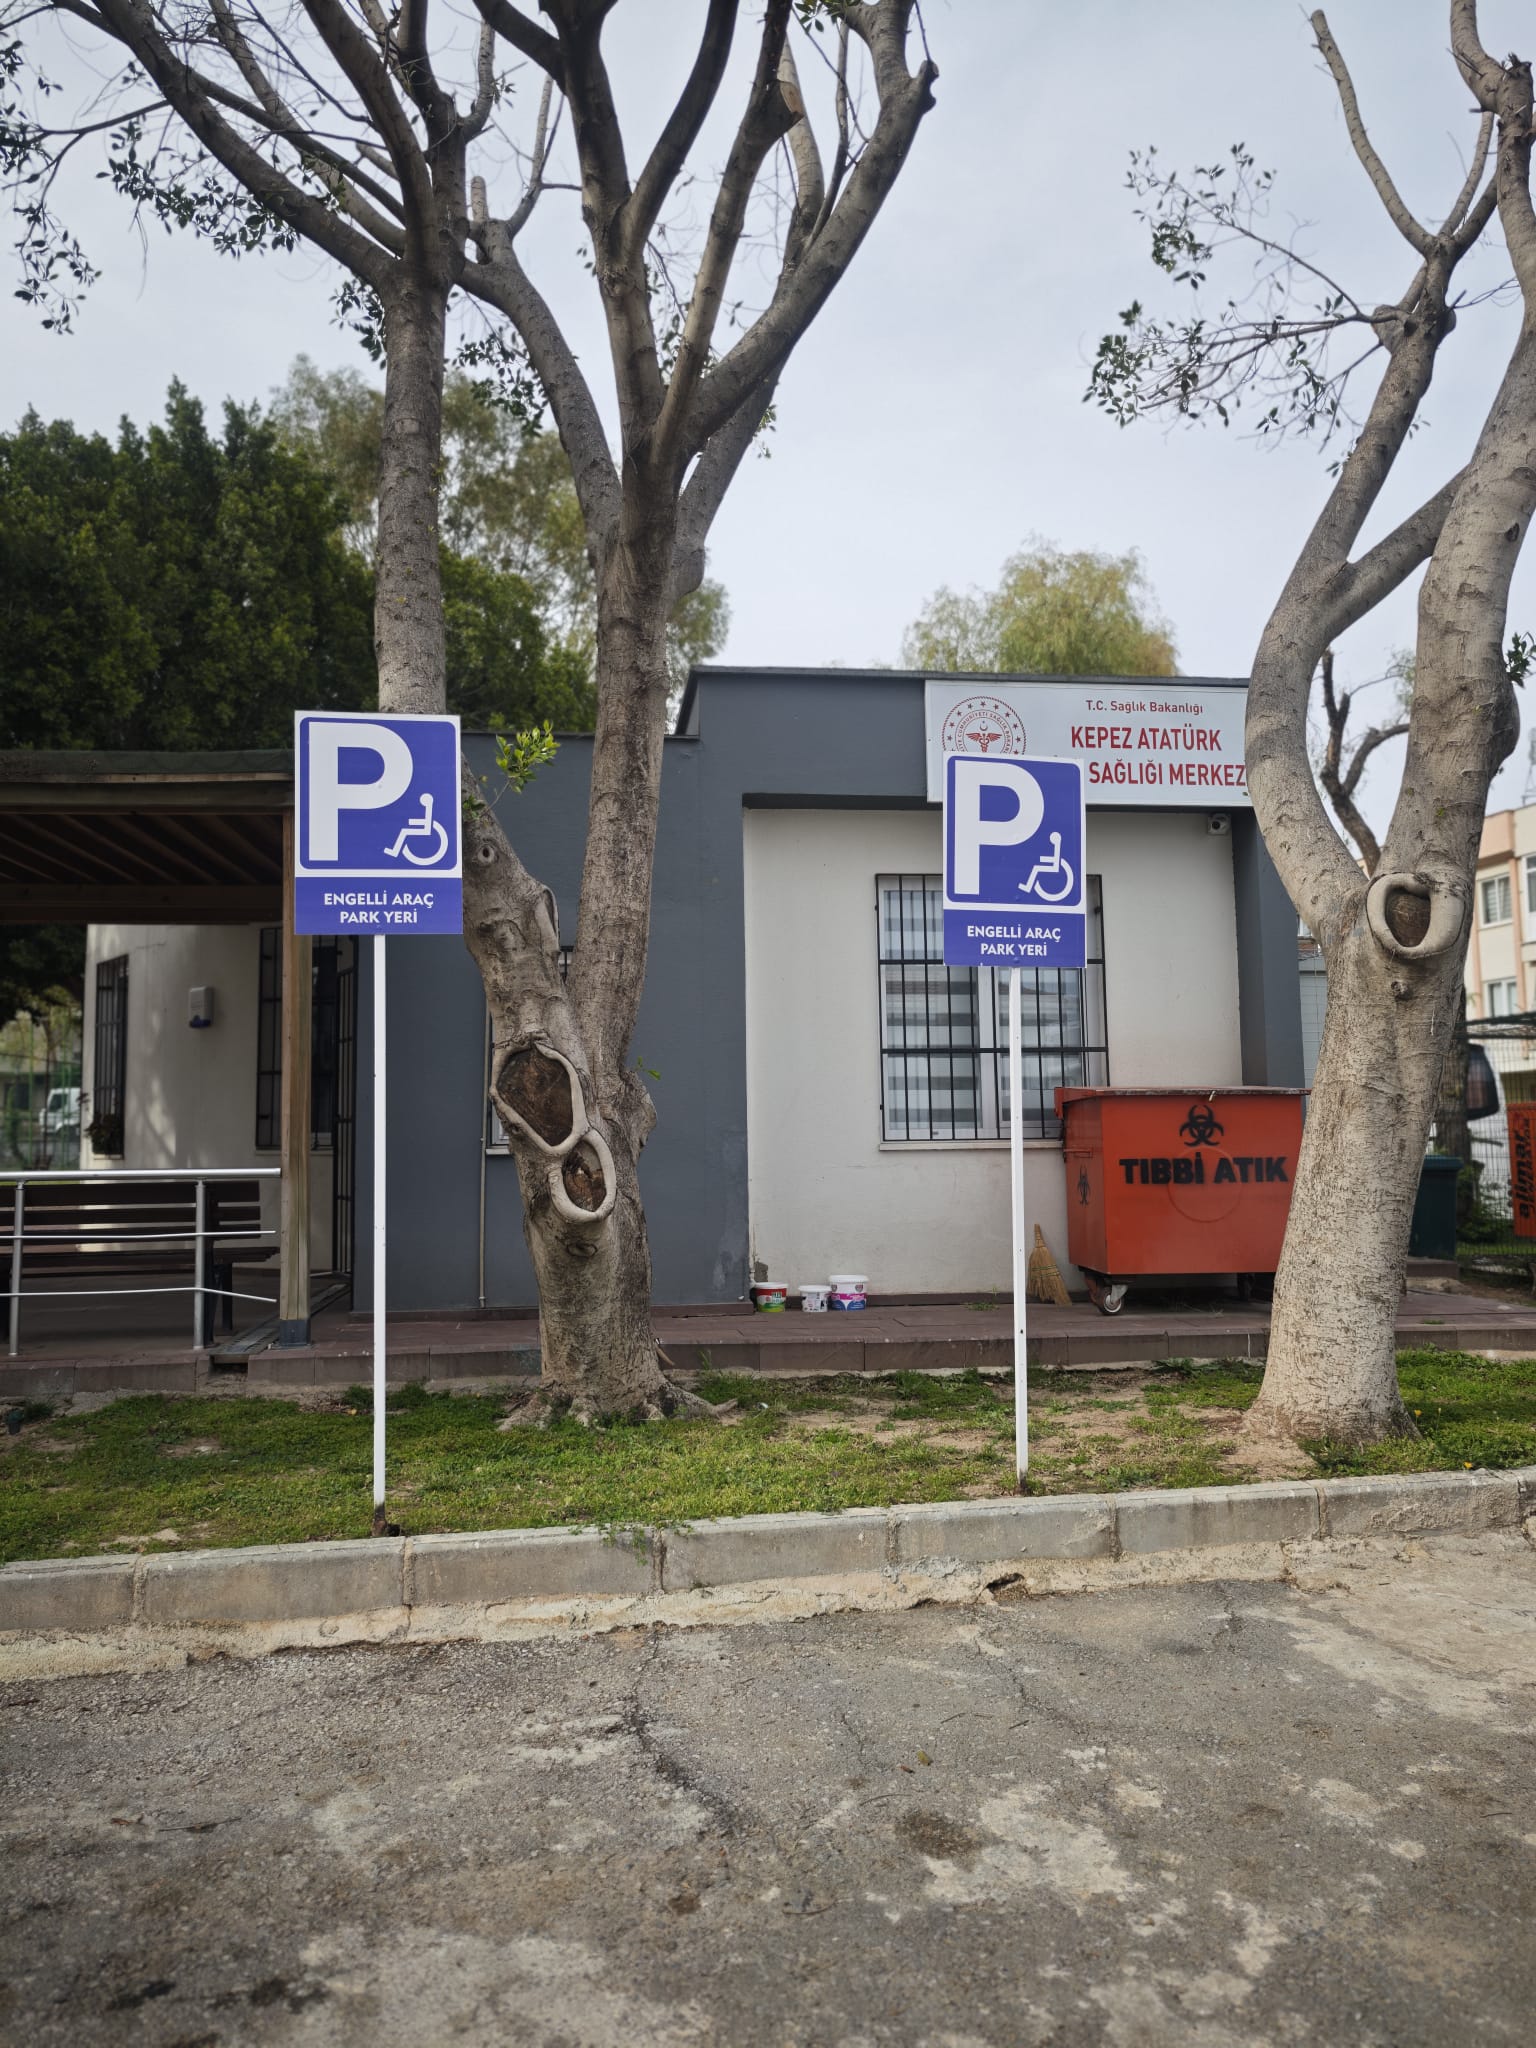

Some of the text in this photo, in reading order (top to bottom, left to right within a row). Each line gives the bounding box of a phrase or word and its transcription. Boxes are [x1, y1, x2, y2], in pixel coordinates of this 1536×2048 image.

[1086, 700, 1203, 715] T.C. Sağlık Bakanlığı
[1071, 723, 1222, 751] KEPEZ ATATÜRK
[1089, 758, 1246, 786] SAĞLIĞI MERKEZ
[309, 721, 413, 861] P
[954, 760, 1044, 895] P
[324, 889, 434, 909] ENGELLİ ARAÇ
[340, 908, 417, 923] PARK YERİ
[967, 923, 1061, 942] ENGELLİ ARAÇ
[980, 941, 1047, 956] PARK YERİ
[1119, 1152, 1289, 1185] TIBBİ ATIK
